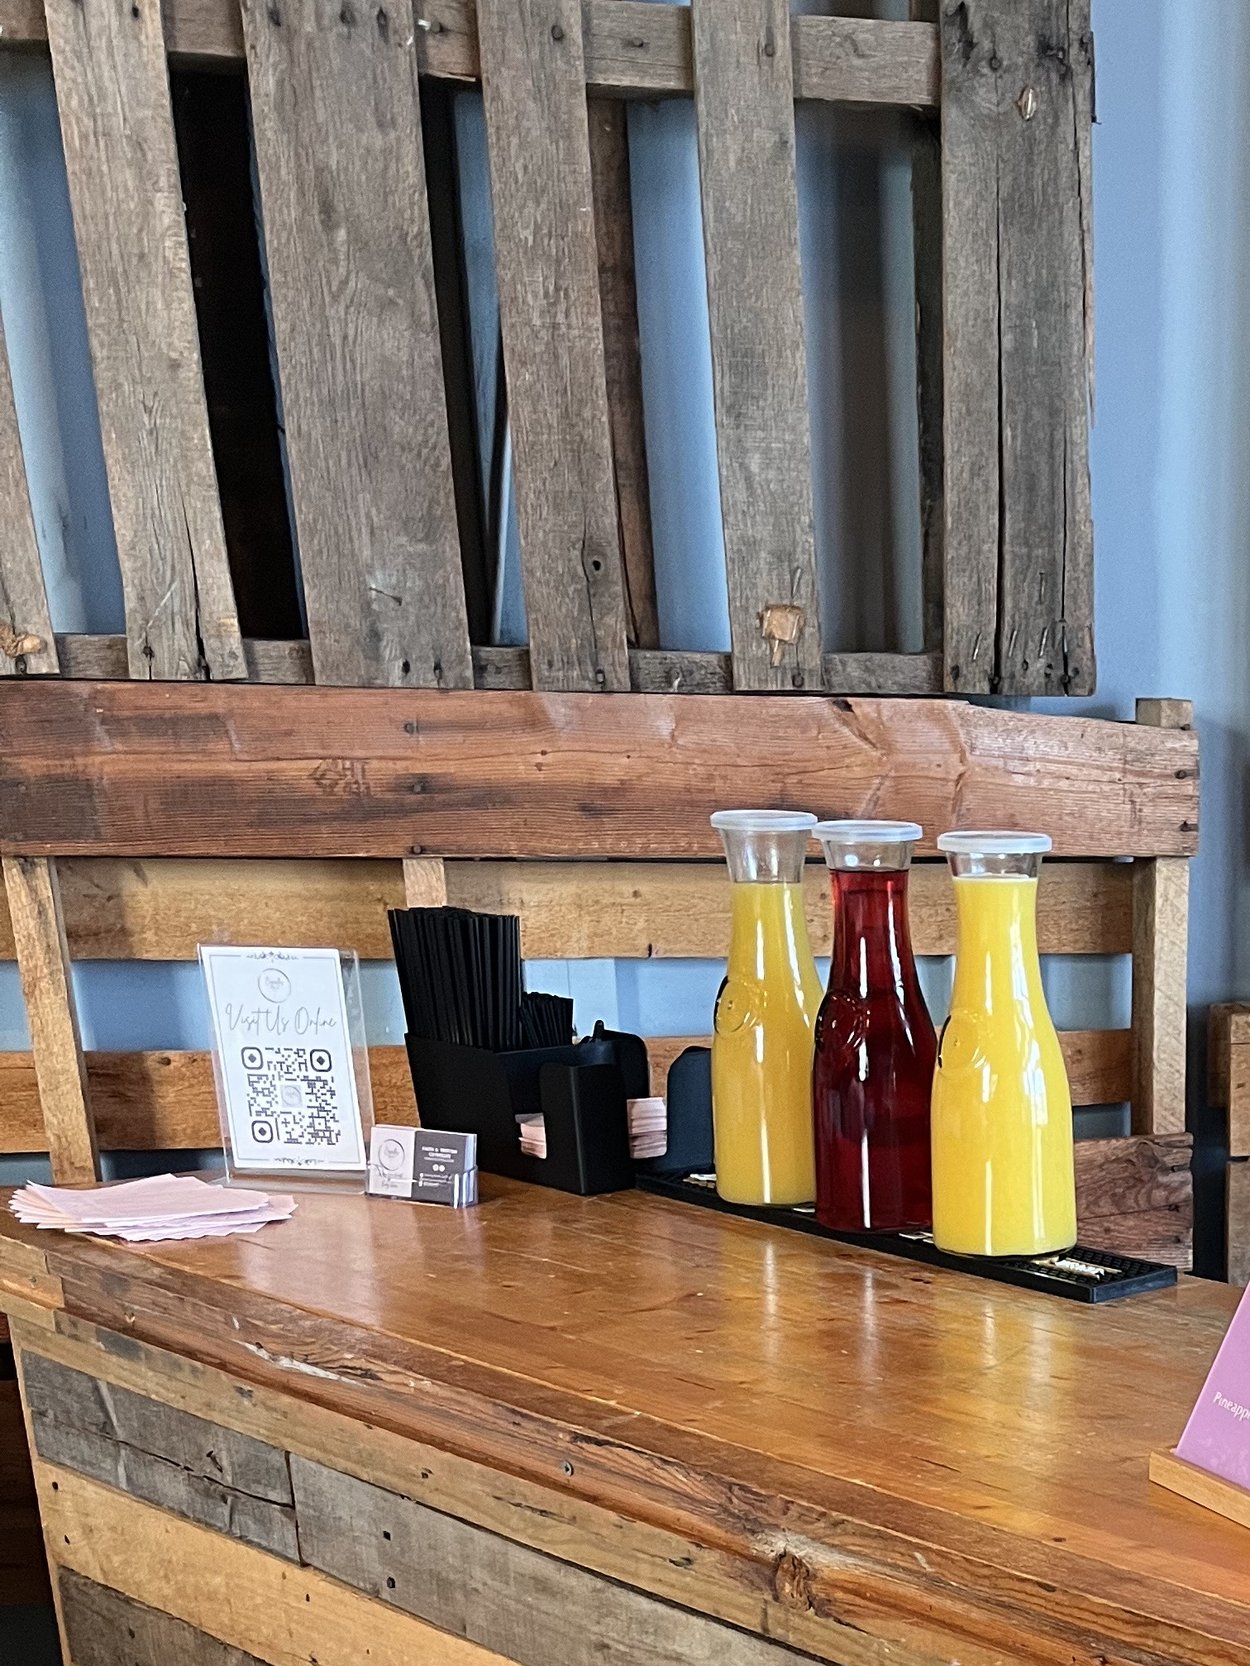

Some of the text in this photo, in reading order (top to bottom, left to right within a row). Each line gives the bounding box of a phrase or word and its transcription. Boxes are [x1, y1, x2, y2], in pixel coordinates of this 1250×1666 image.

[225, 1003, 337, 1036] Visit Us Online
